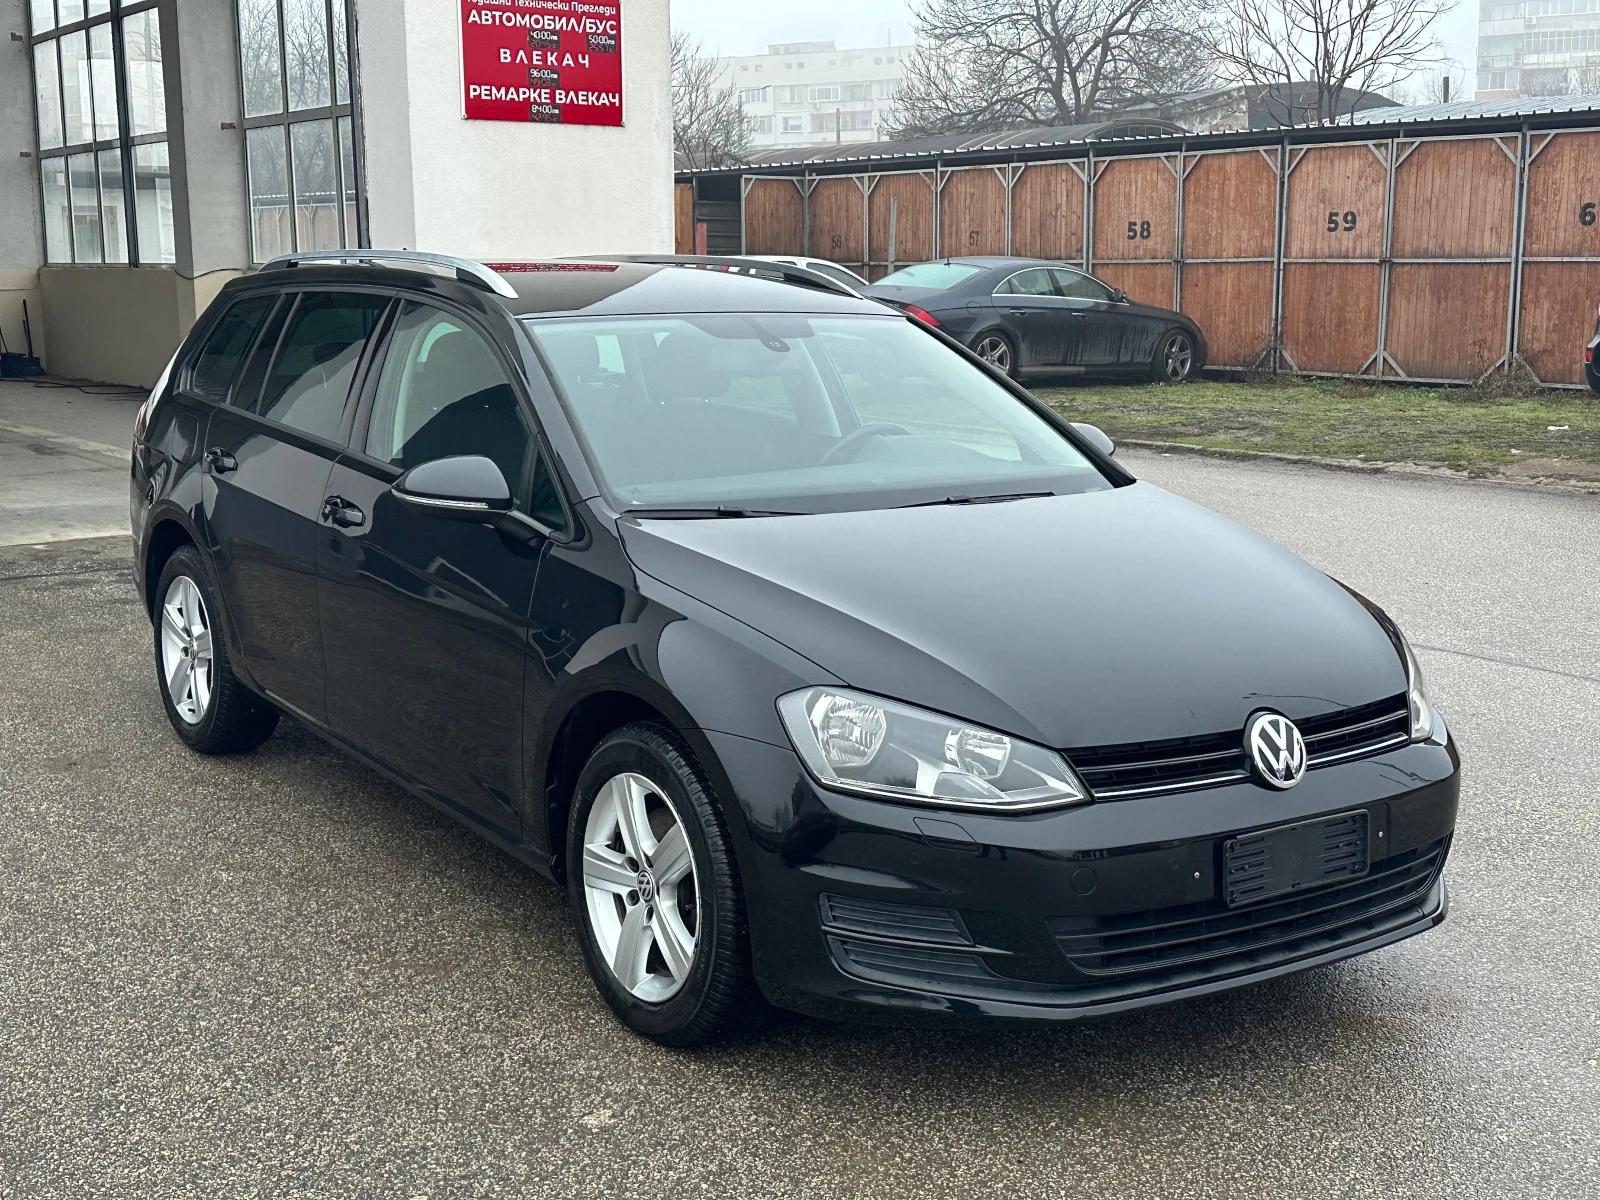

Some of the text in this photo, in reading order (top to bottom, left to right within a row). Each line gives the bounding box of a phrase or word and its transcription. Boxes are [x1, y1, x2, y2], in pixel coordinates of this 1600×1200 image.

[571, 1, 616, 16] Прегледи
[467, 9, 617, 34] АВТОМОБИЛ/БУС
[500, 48, 589, 68] ВЛЕКАЧ
[469, 85, 620, 107] РЕМАРКЕ ВЛЕКАЧ
[1327, 211, 1357, 233] 59
[1579, 202, 1597, 226] 6
[969, 230, 980, 247] 57
[1126, 220, 1152, 241] 58
[832, 234, 842, 249] 56
